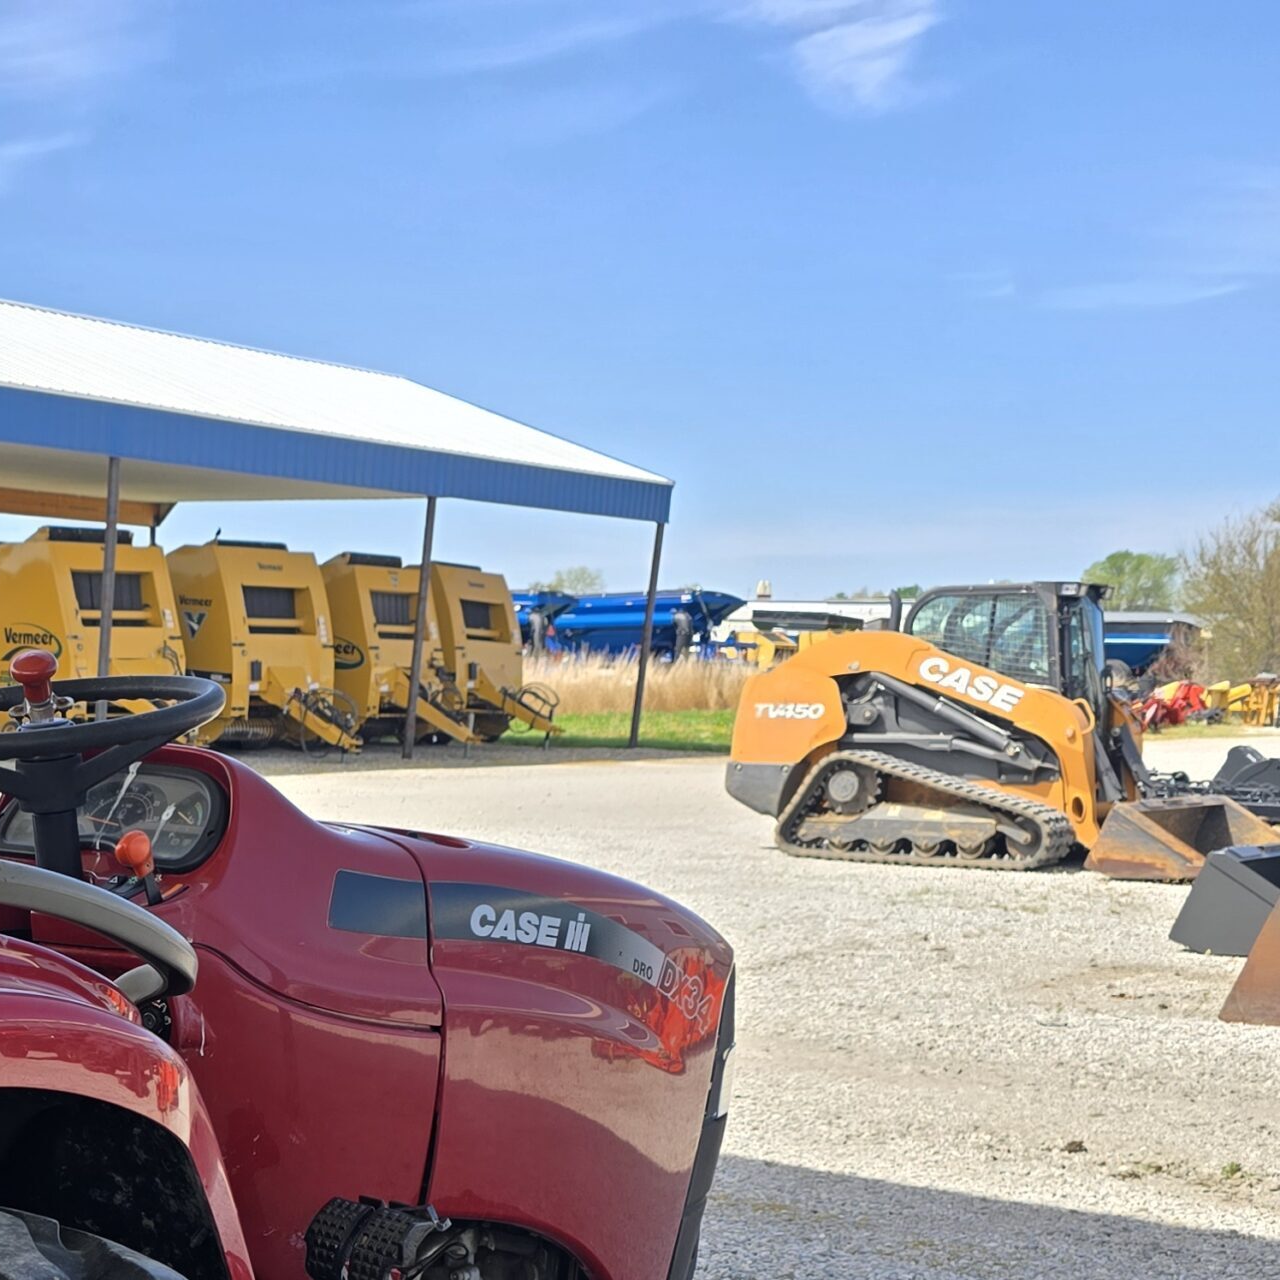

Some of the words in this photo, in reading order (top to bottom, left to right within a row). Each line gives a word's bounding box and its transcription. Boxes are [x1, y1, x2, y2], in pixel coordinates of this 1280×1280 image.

[178, 595, 212, 607] Vermeer
[4, 627, 54, 646] Vermeer
[919, 656, 1025, 712] CASE
[470, 904, 562, 948] CASE
[632, 958, 653, 980] DRO
[657, 956, 716, 1035] DX34
